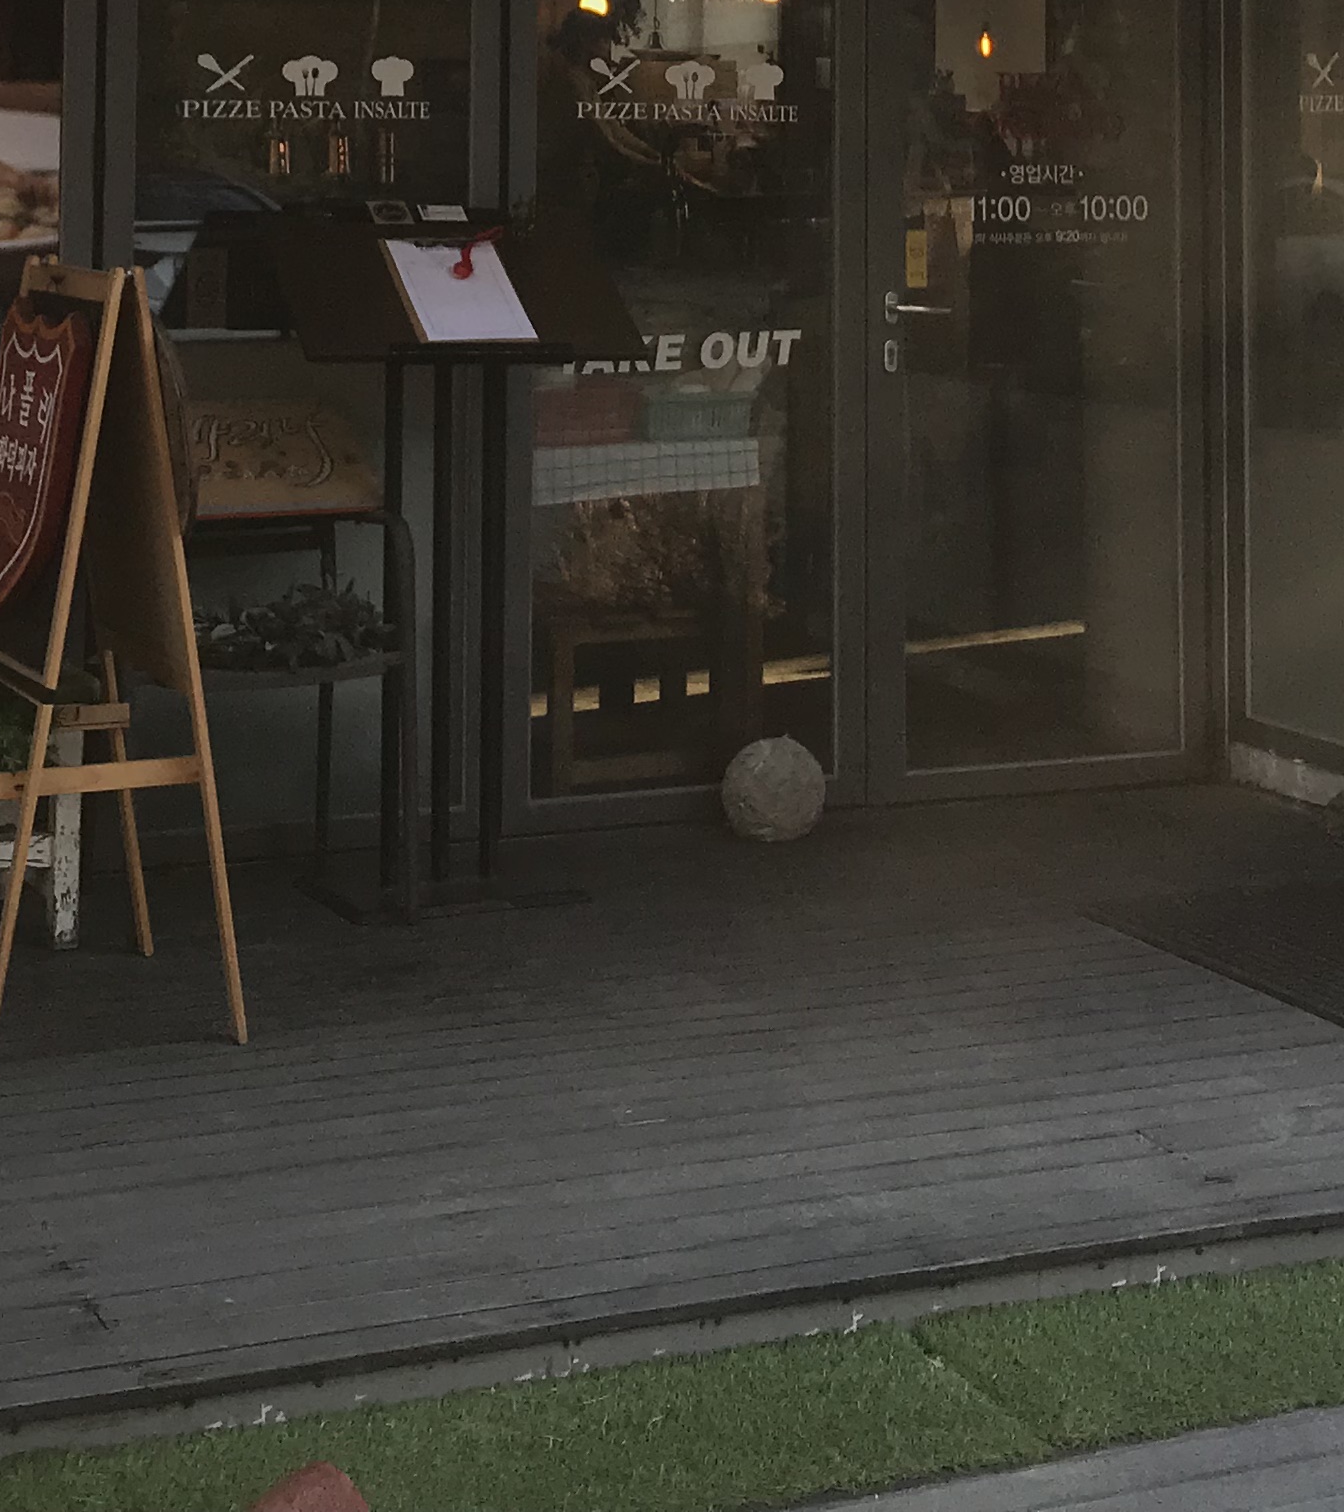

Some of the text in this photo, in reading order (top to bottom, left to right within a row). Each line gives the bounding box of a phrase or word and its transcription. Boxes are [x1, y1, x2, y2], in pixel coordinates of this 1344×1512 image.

[182, 100, 431, 120] PIZZE PASTA INSALTE
[576, 102, 799, 122] PIZZE PASTA INSALTE
[1299, 95, 1344, 113] PIZZE
[1080, 195, 1149, 221] 10:00
[700, 329, 802, 369] OUT
